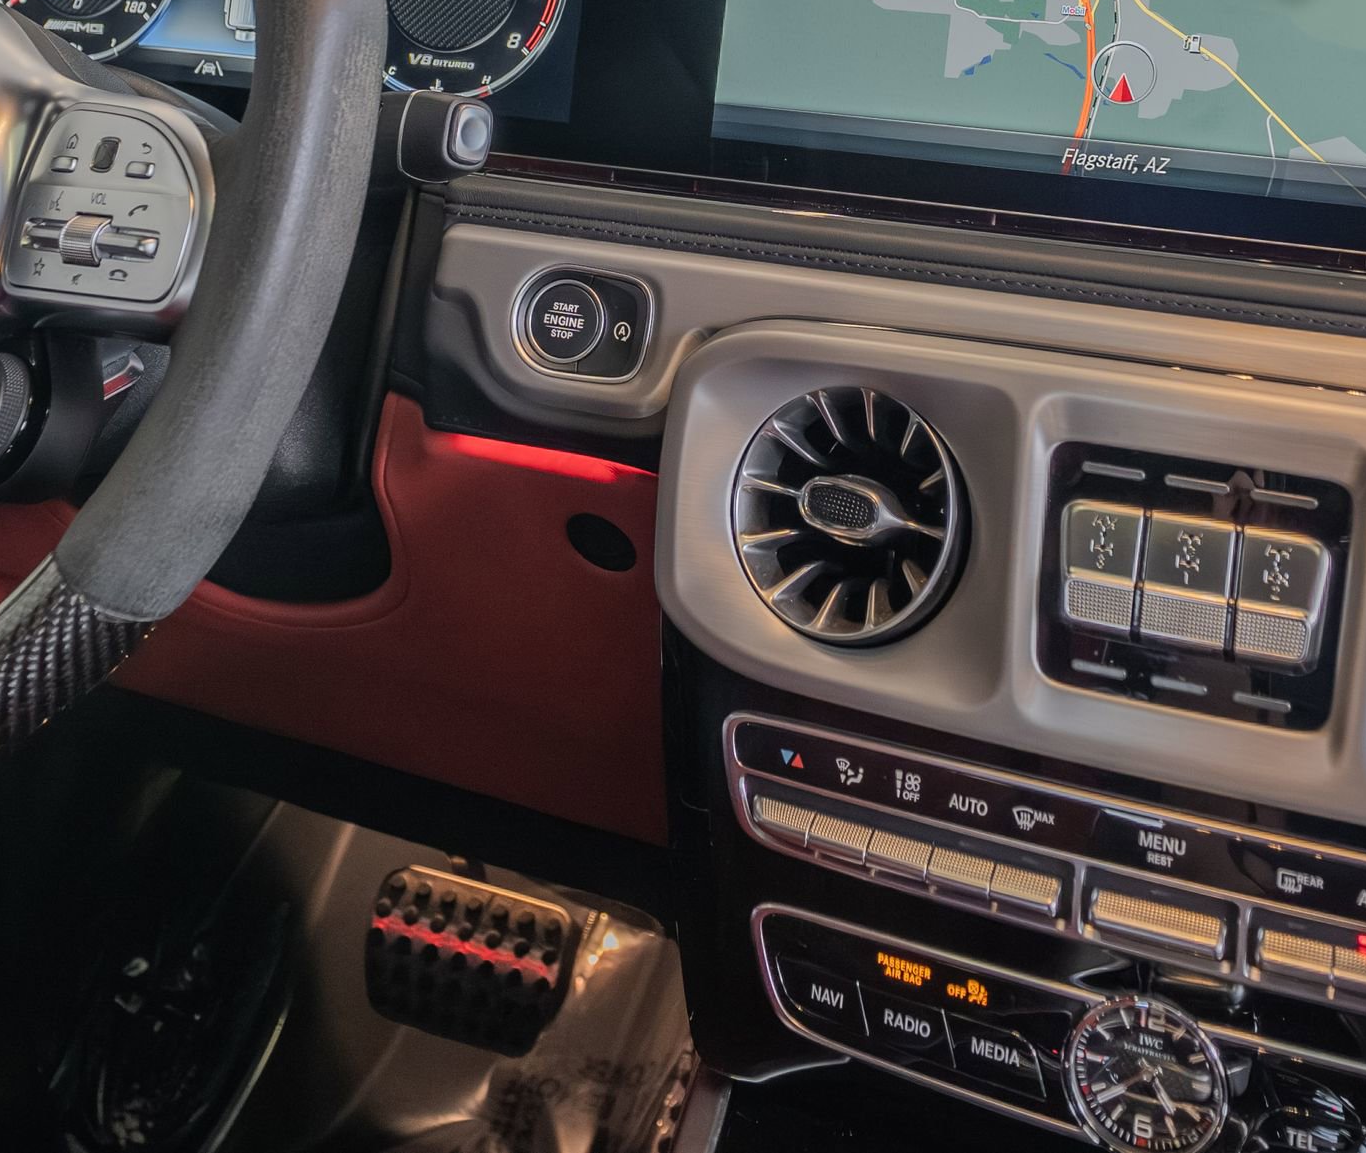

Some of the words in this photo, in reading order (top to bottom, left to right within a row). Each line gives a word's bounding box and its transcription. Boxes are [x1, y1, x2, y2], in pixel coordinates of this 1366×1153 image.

[124, 0, 147, 14] 180
[1061, 5, 1086, 16] Mobil
[506, 32, 522, 49] 8
[408, 52, 433, 66] V8
[433, 58, 475, 70] BITURBO
[388, 65, 397, 76] C
[481, 74, 492, 85] H
[1061, 147, 1139, 175] Flagstaff,
[1142, 156, 1171, 175] AZ
[91, 191, 107, 206] VOL
[552, 301, 580, 314] START
[543, 313, 585, 330] ENGINE
[550, 328, 574, 340] STOP
[902, 790, 921, 803] OFF
[948, 792, 989, 817] AUTO
[1033, 811, 1056, 827] MAX
[1139, 829, 1187, 857] MENU
[1146, 850, 1175, 869] REST
[1297, 873, 1325, 891] REAR
[877, 951, 932, 980] PASSENGER
[884, 966, 901, 980] AIR
[902, 972, 923, 987] BAG
[810, 982, 844, 1010] NAVI
[946, 983, 967, 1000] OFF
[883, 1008, 932, 1040] RADIO
[1138, 1032, 1164, 1051] IWC
[970, 1036, 1021, 1068] MEDIA
[1133, 1113, 1153, 1139] 6
[1285, 1125, 1319, 1153] TEL
